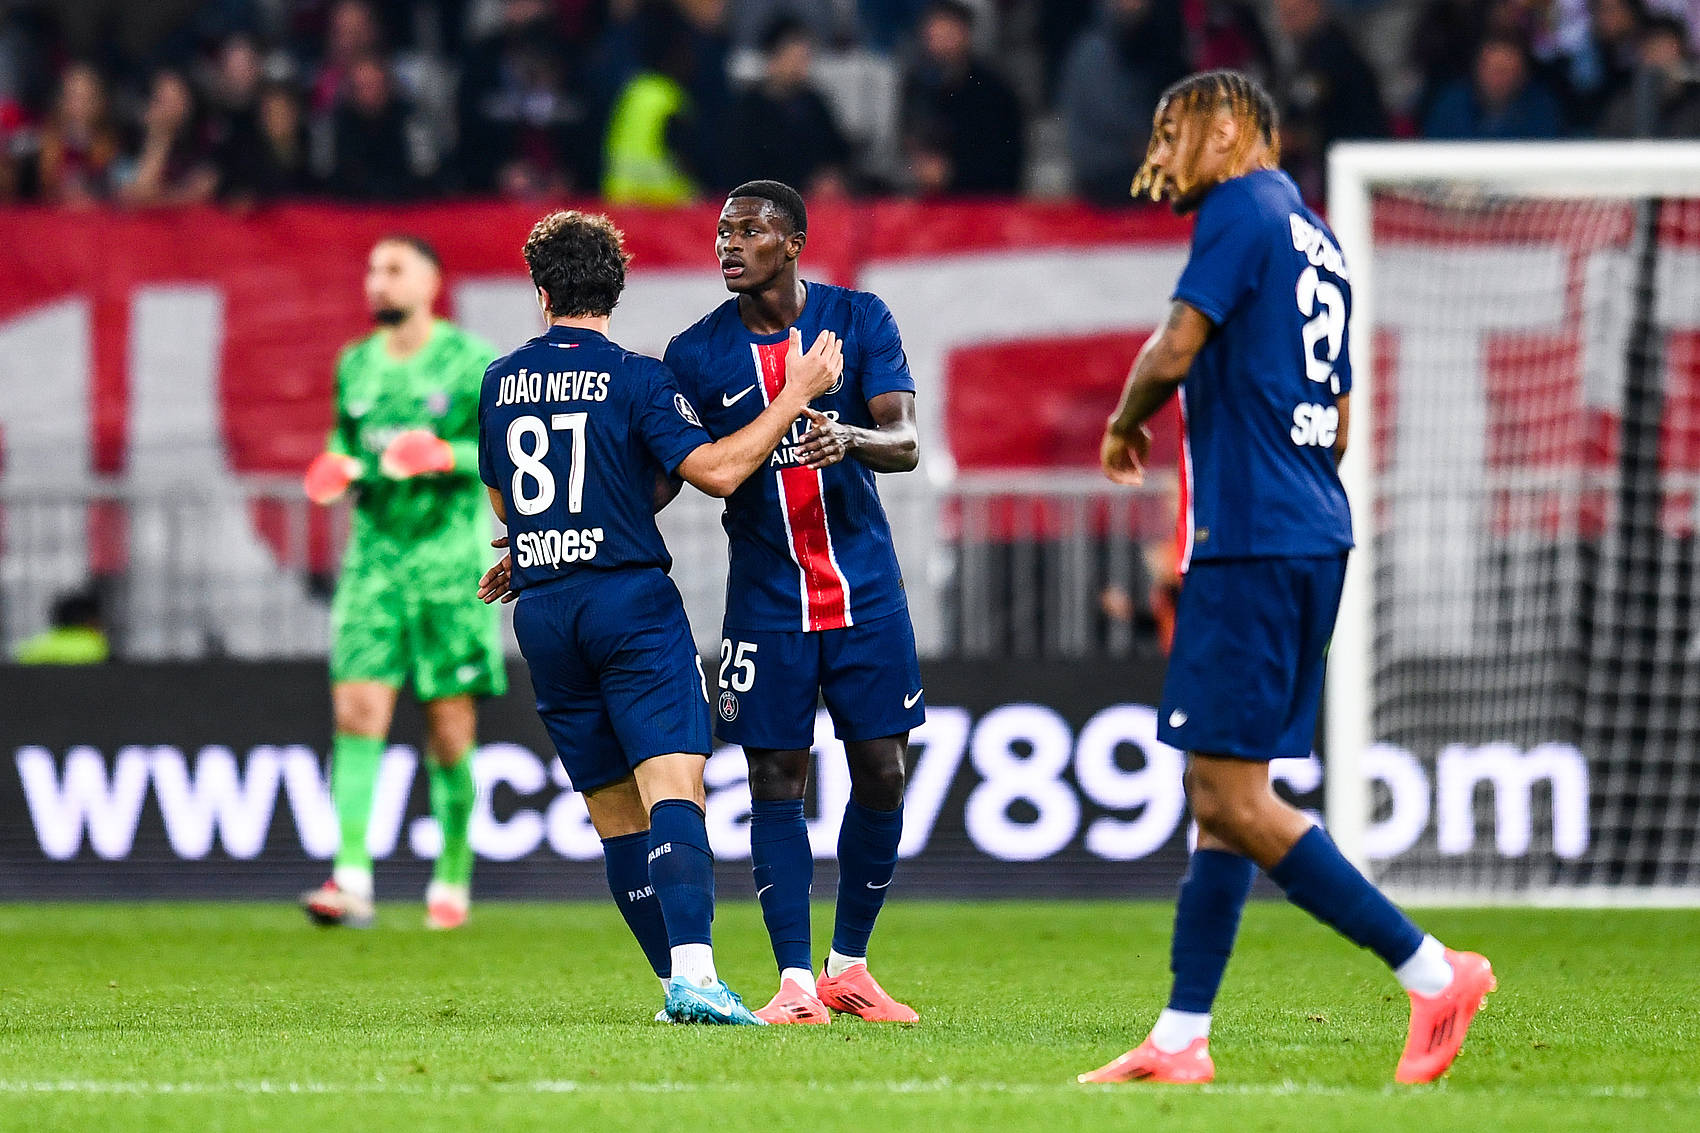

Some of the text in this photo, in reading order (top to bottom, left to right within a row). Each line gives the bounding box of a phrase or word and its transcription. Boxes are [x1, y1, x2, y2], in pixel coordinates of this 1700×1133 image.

[496, 369, 611, 407] JOÃO NEVES
[507, 412, 588, 515] 87
[719, 638, 758, 692] 25
